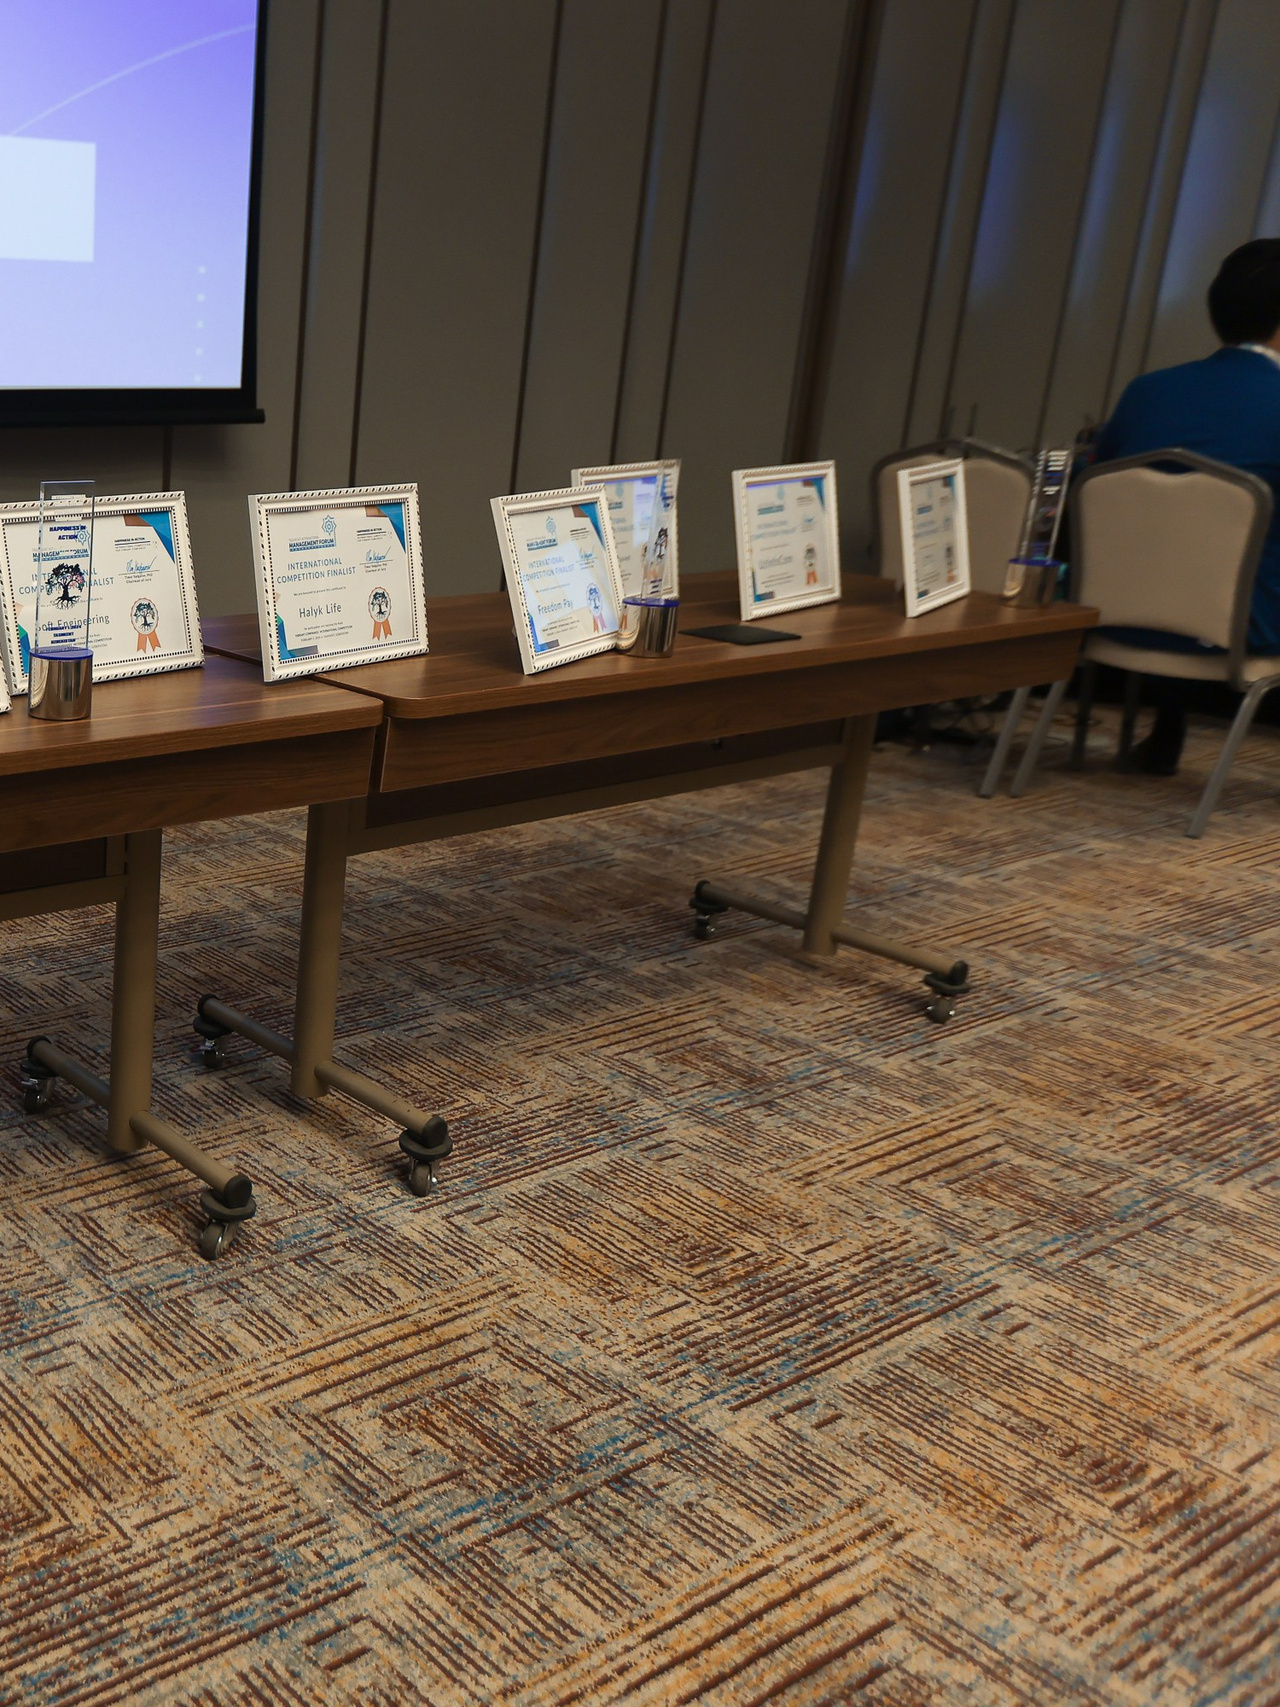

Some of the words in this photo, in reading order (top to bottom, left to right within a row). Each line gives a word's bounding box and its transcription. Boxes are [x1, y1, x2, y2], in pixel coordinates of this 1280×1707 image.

[288, 558, 342, 571] INTERNATIONAL
[277, 571, 325, 584] COMPETITION
[327, 567, 356, 577] FINALIST
[299, 604, 323, 618] Halyk
[326, 603, 342, 614] Life
[538, 603, 562, 615] Freedom
